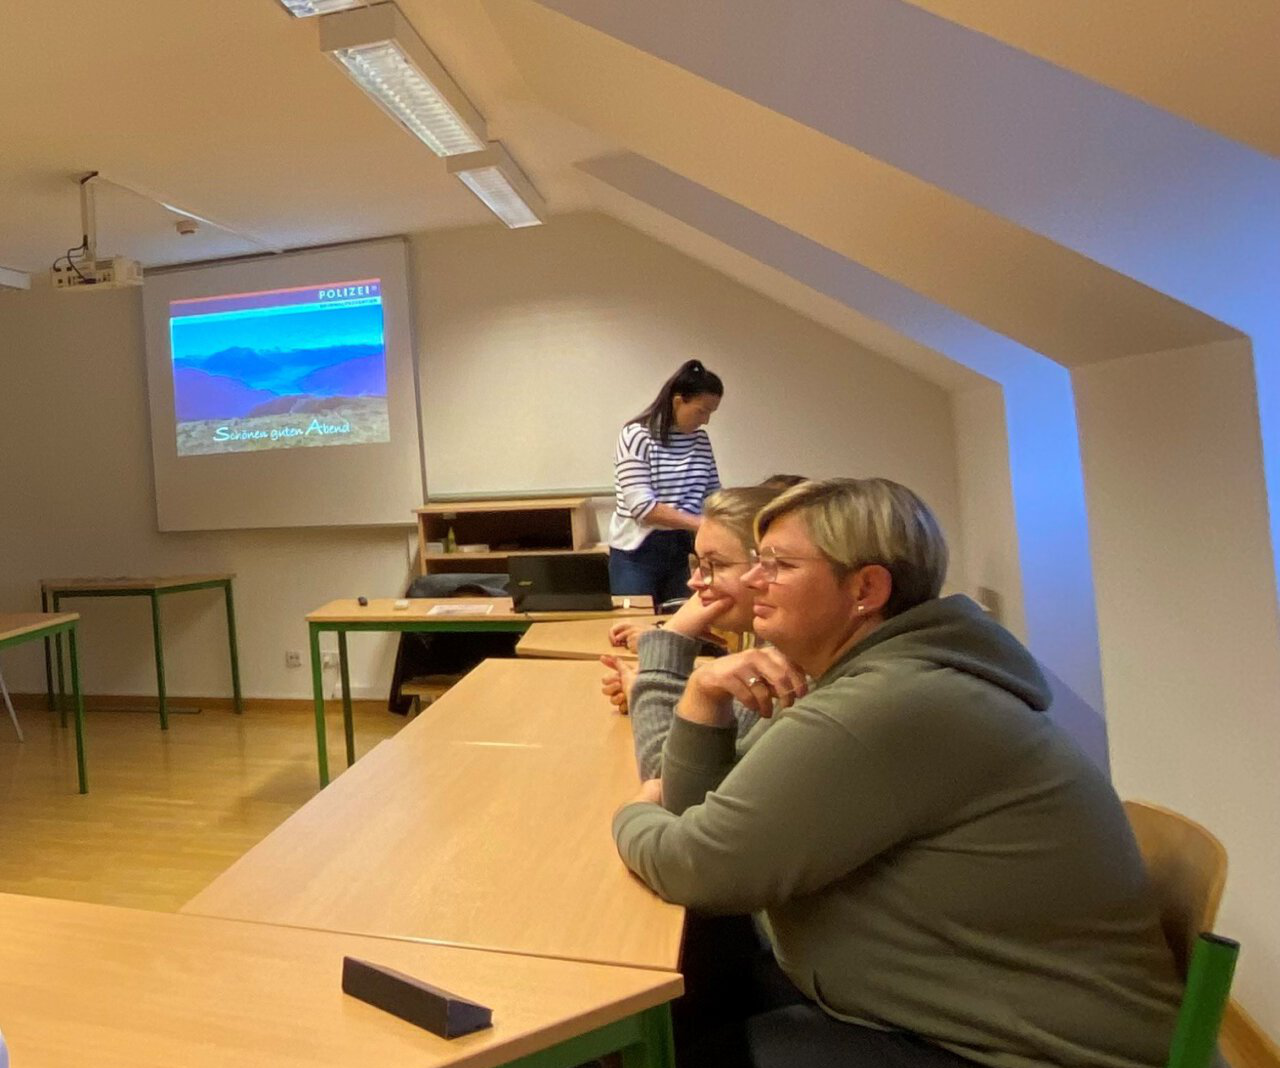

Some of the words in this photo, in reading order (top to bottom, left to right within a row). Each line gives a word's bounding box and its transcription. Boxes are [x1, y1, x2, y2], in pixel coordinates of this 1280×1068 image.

[319, 286, 369, 300] POLIZEI
[270, 427, 304, 441] guten
[305, 419, 350, 436] Abend
